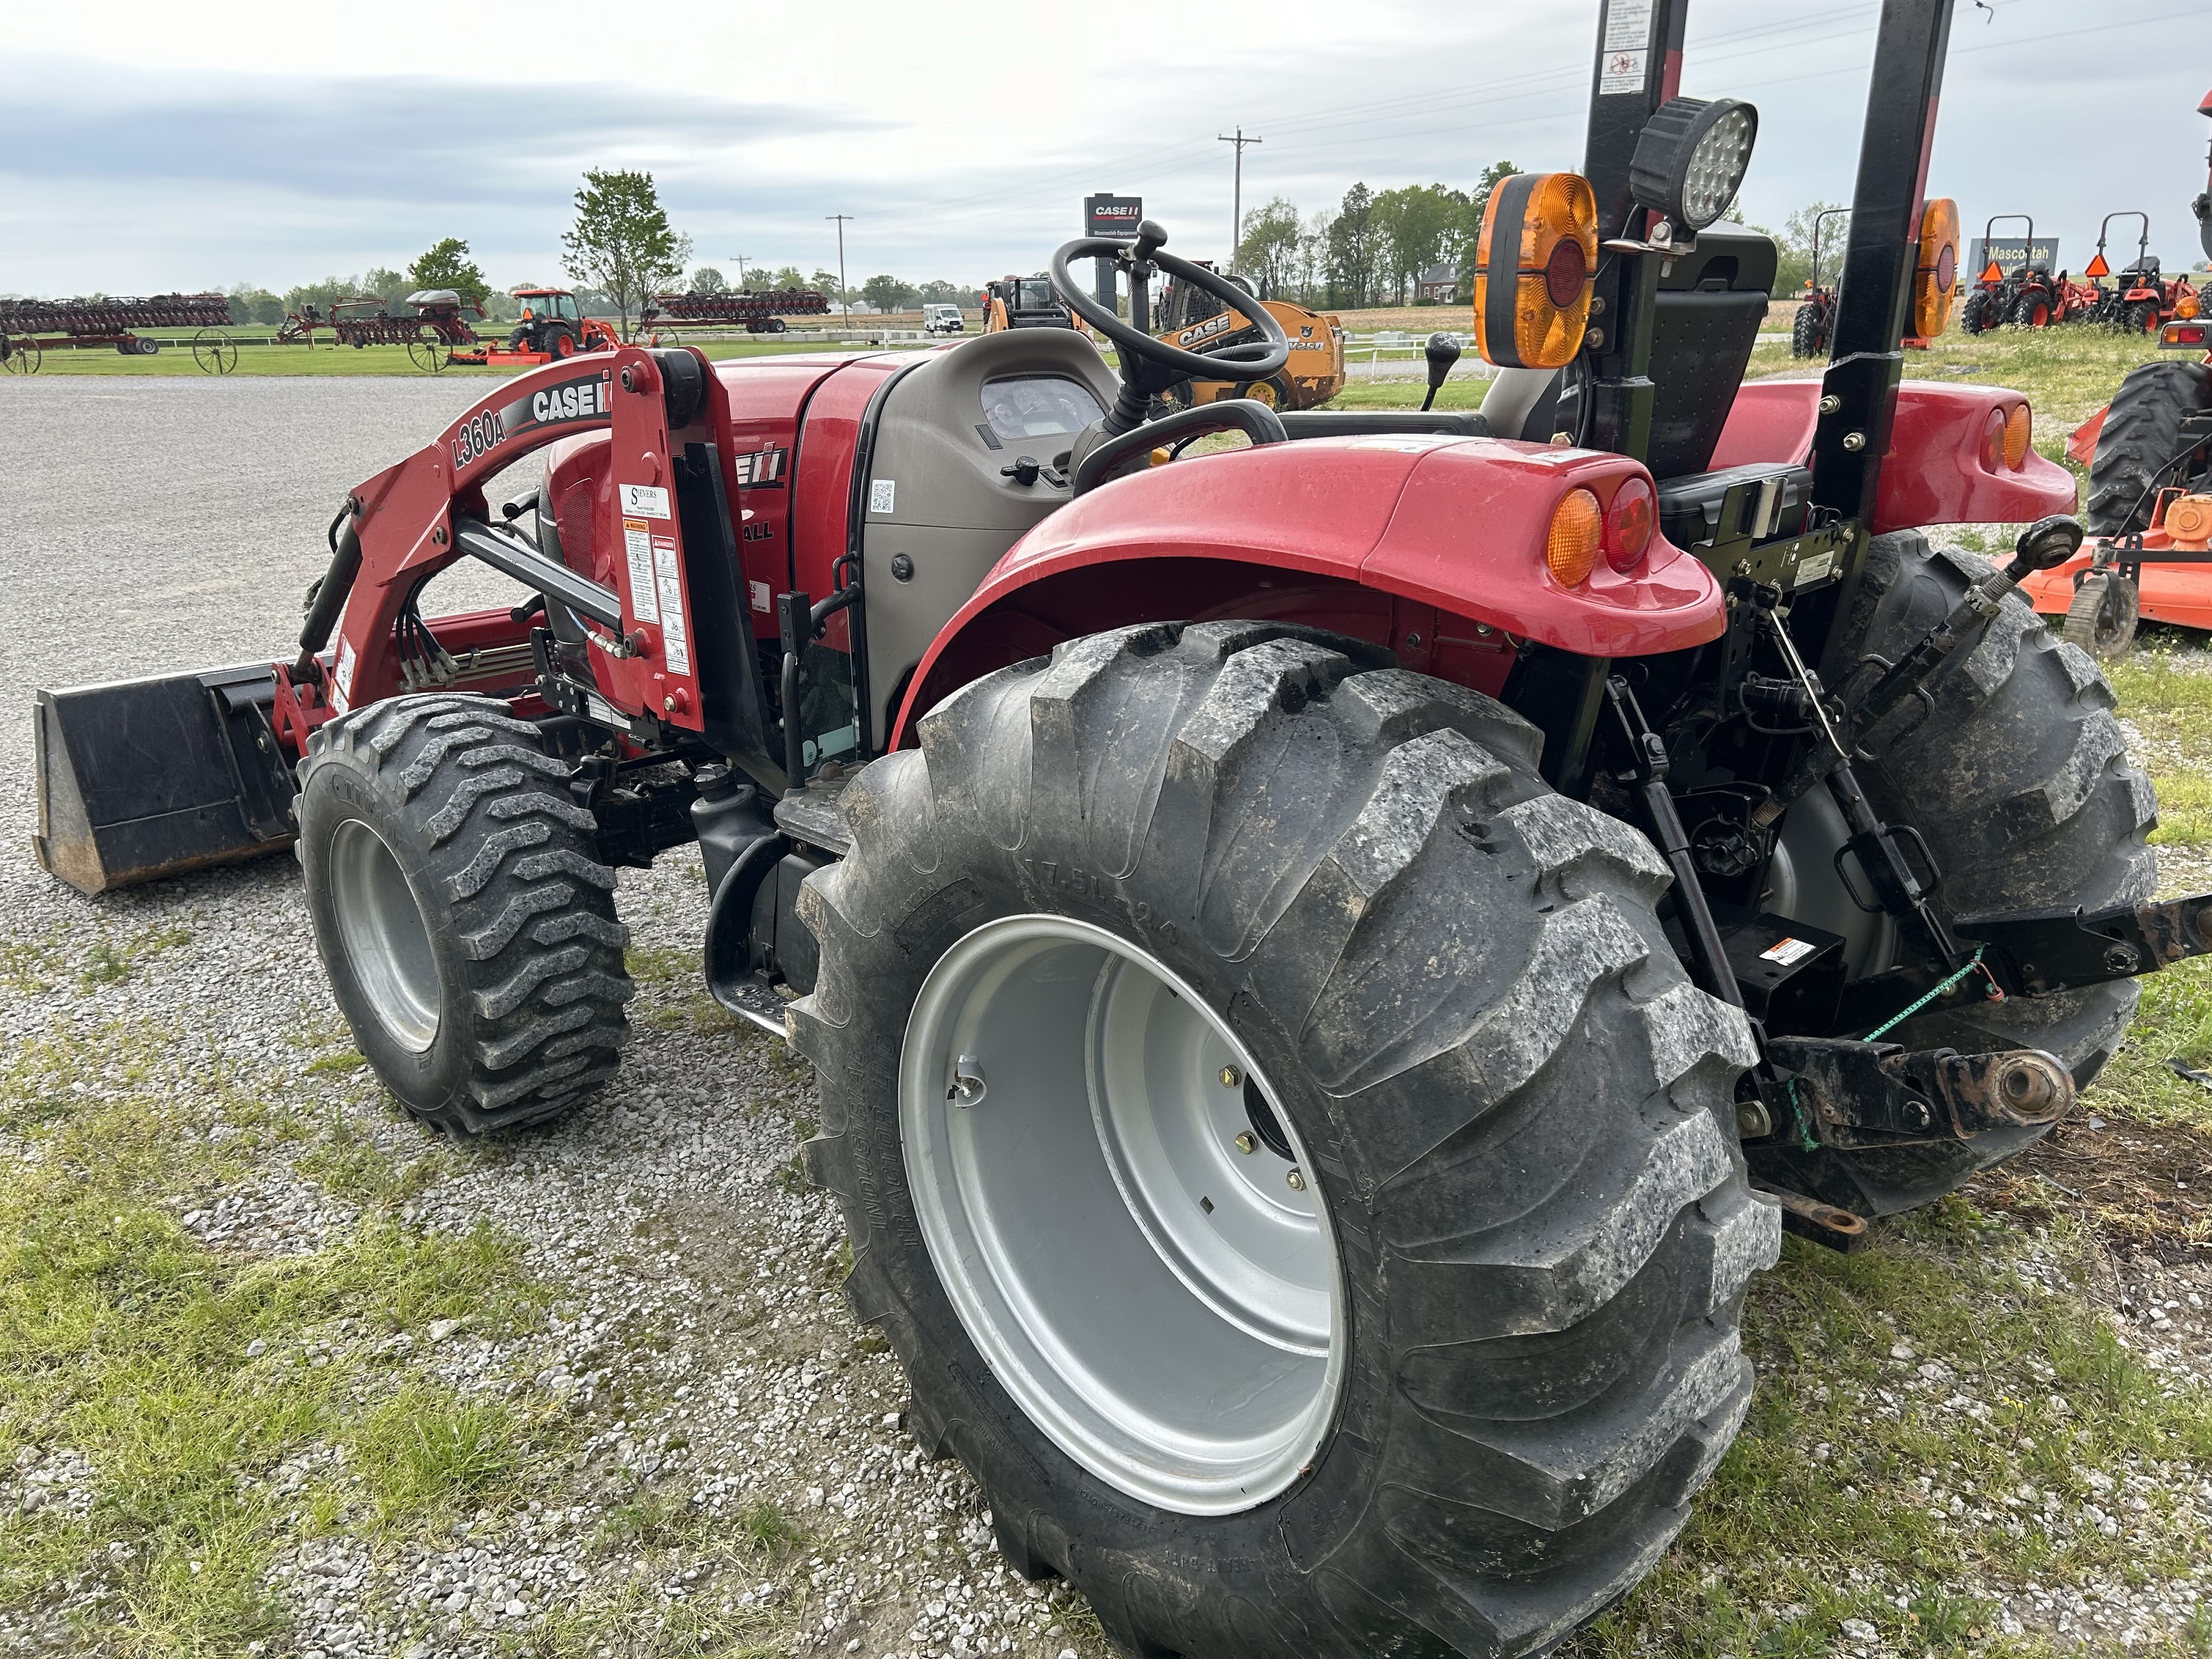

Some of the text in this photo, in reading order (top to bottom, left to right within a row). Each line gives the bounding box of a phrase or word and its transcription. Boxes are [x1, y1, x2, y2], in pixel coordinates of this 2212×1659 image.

[1095, 206, 1128, 215] CASE
[1178, 315, 1231, 348] CASE
[533, 383, 594, 422] CASE
[451, 409, 507, 471] L360A
[631, 487, 657, 505] SIEVERS
[743, 521, 774, 542] ALL
[847, 1051, 887, 1231] INDUSTRIAL
